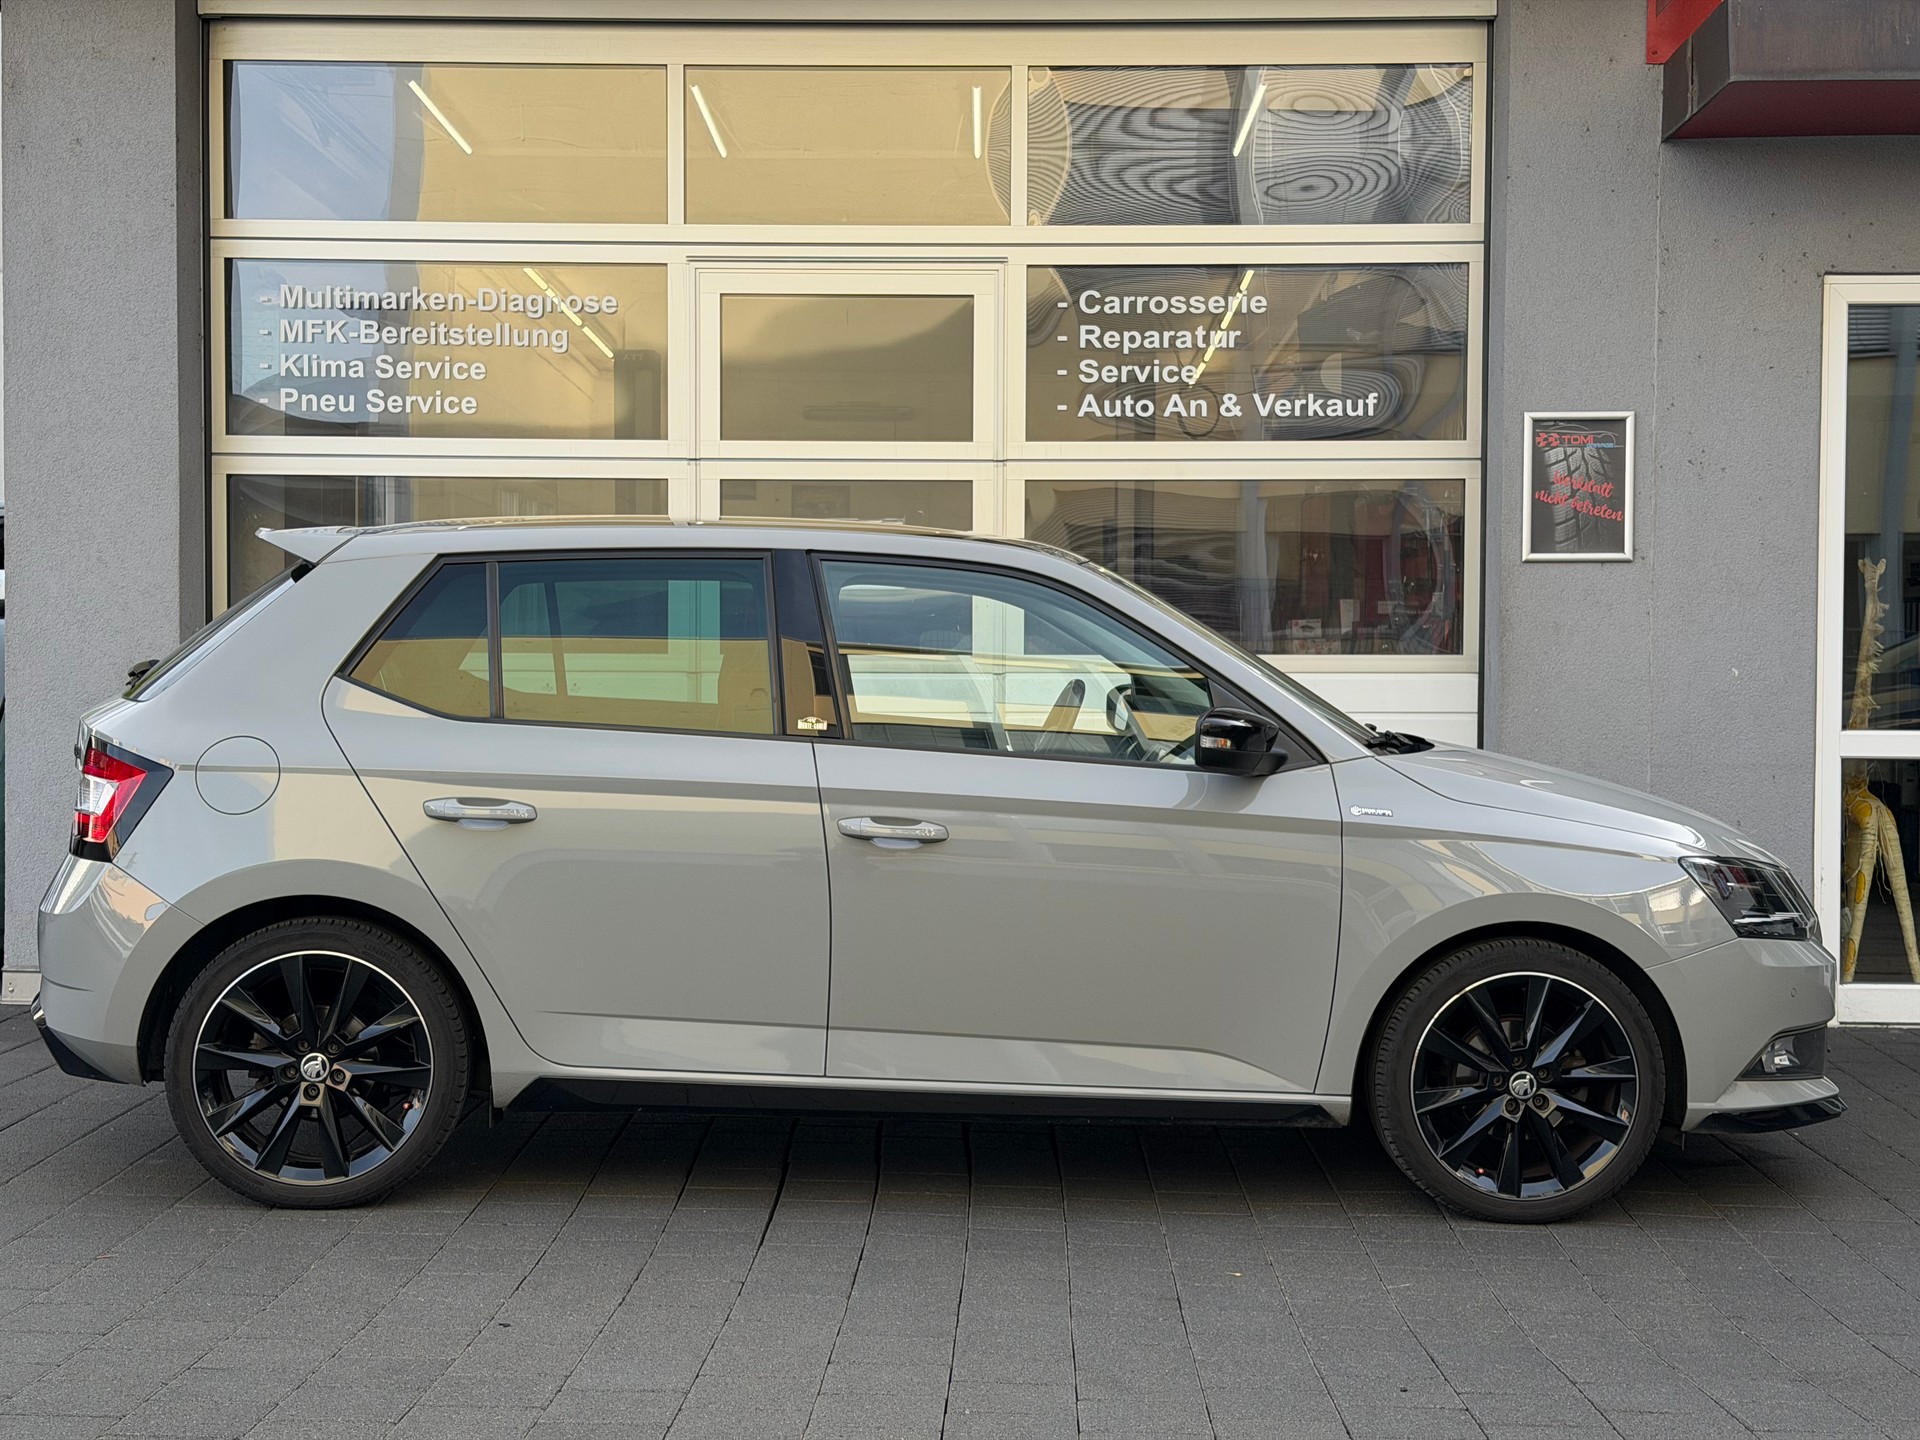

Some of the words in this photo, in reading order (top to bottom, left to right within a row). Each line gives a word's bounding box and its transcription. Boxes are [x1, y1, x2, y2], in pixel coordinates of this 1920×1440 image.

[279, 284, 619, 318] Multimarken-Diagnose
[1078, 289, 1268, 315] Carrosserie
[279, 319, 569, 352] MFK-Bereitstellung
[1079, 324, 1241, 354] Reparatur
[279, 353, 365, 378] Klima
[374, 355, 487, 380] Service
[1078, 360, 1198, 384] Service
[279, 387, 356, 412] Pneu
[366, 388, 478, 415] Service
[1078, 394, 1155, 418] Auto
[1164, 394, 1209, 417] An
[1219, 394, 1242, 418] &
[1253, 392, 1379, 417] Verkauf
[1563, 434, 1594, 444] TOMI
[1535, 490, 1569, 506] nicht
[1571, 496, 1623, 521] betreten
[363, 942, 416, 978] UNIROYAL
